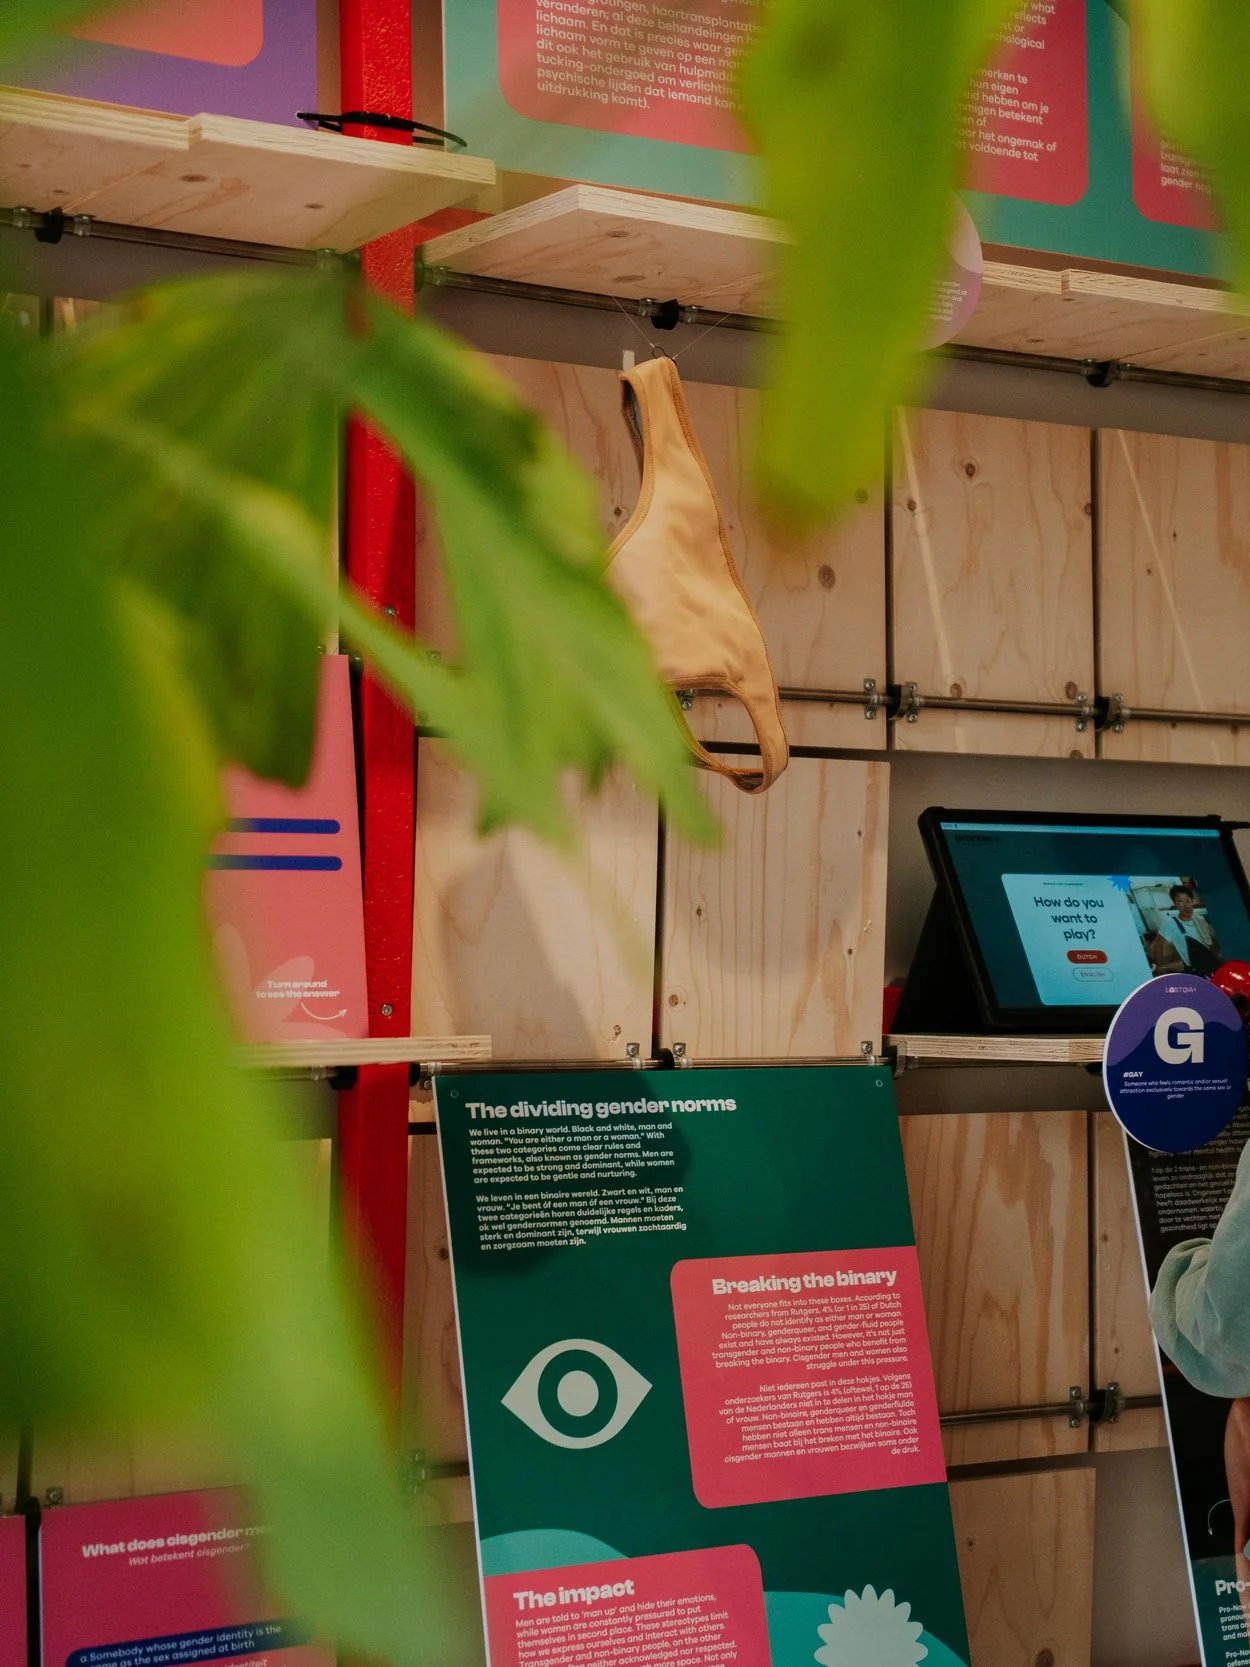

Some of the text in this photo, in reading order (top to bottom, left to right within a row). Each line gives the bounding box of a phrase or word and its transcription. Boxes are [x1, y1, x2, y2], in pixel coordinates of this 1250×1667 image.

[1031, 2, 1056, 14] what
[536, 24, 715, 65] lichaam vorm te geven op een
[591, 20, 607, 32] En
[609, 23, 631, 37] dat
[647, 32, 690, 47] precies
[692, 40, 721, 52] waar
[536, 38, 676, 71] dit ook het gebruik van
[537, 69, 735, 108] psychische lijden dat iemand kan
[991, 81, 1019, 94] eigen
[1017, 74, 1028, 84] te
[537, 81, 650, 110] uitdrukking komt).
[982, 91, 1049, 114] hebben om je
[999, 107, 1043, 124] betekent
[979, 128, 1057, 151] het ongemak of
[969, 142, 1039, 161] voldoende tot
[1033, 896, 1104, 911] How do you
[1051, 913, 1098, 925] want to
[1063, 928, 1096, 942] play?
[266, 980, 328, 988] Turn around
[256, 990, 266, 998] to
[285, 990, 301, 998] the
[302, 990, 340, 998] answer
[465, 1097, 736, 1119] The dividing gender norms
[468, 1128, 482, 1136] We
[483, 1127, 498, 1136] live
[500, 1127, 508, 1135] in
[516, 1126, 543, 1136] binary
[545, 1125, 570, 1134] world.
[571, 1124, 594, 1133] Black
[595, 1123, 611, 1132] and
[612, 1123, 636, 1132] white,
[656, 1121, 672, 1130] and
[470, 1138, 502, 1146] woman.
[540, 1134, 565, 1143] either
[645, 1131, 664, 1140] With
[470, 1147, 494, 1155] these
[512, 1144, 557, 1155] categories
[582, 1142, 602, 1151] clear
[604, 1141, 624, 1150] rules
[625, 1140, 640, 1149] and
[712, 1270, 897, 1295] Breaking the binary
[728, 1303, 742, 1311] Not
[743, 1301, 777, 1311] everyone
[778, 1299, 791, 1307] fits
[792, 1298, 807, 1306] into
[808, 1297, 829, 1305] these
[854, 1292, 891, 1302] According
[82, 1542, 125, 1558] What
[127, 1538, 164, 1552] does
[166, 1527, 242, 1547] cisgender
[128, 1555, 148, 1566] Wat
[150, 1549, 194, 1563] betekent
[512, 1580, 634, 1611] The impact
[515, 1619, 534, 1628] Men
[535, 1617, 550, 1625] are
[551, 1613, 569, 1623] told
[570, 1613, 580, 1621] to
[618, 1604, 635, 1614] and
[636, 1602, 655, 1612] hide
[656, 1599, 675, 1609] their
[89, 1644, 143, 1661] Somebody
[145, 1641, 177, 1653] whose
[179, 1634, 213, 1650] gender
[216, 1628, 253, 1642] identity
[264, 1624, 281, 1635] the
